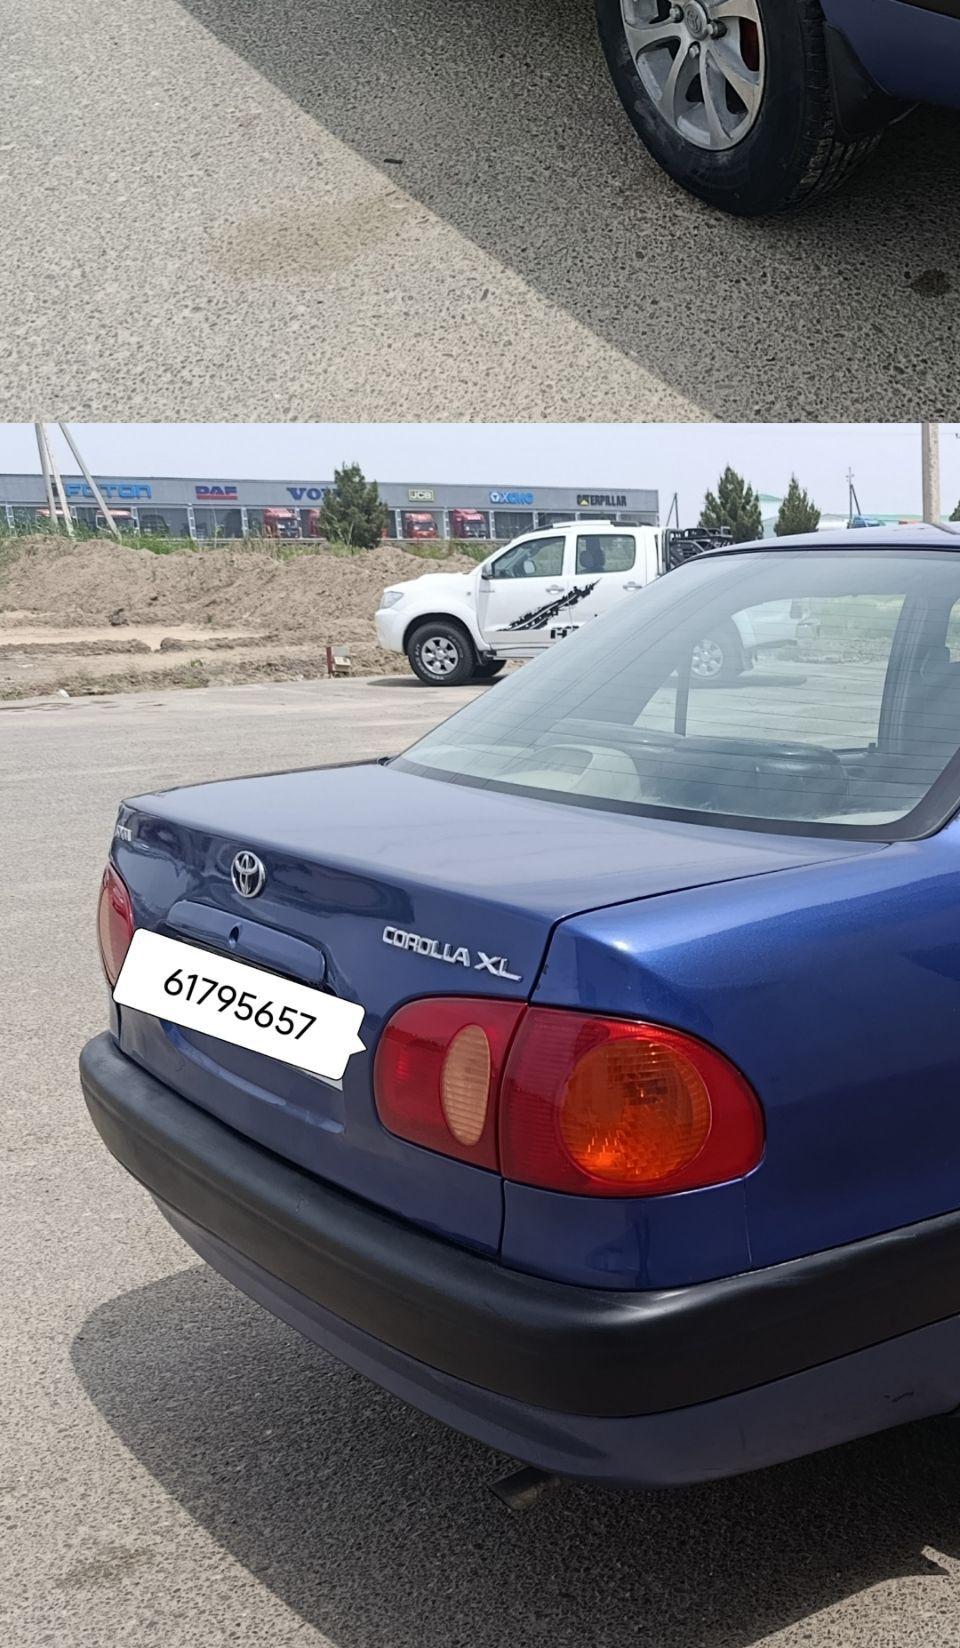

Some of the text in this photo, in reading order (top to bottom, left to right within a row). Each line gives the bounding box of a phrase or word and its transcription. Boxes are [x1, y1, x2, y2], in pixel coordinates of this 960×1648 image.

[195, 486, 238, 497] DAF
[409, 489, 432, 500] JCB
[382, 925, 524, 982] COROLLA XL
